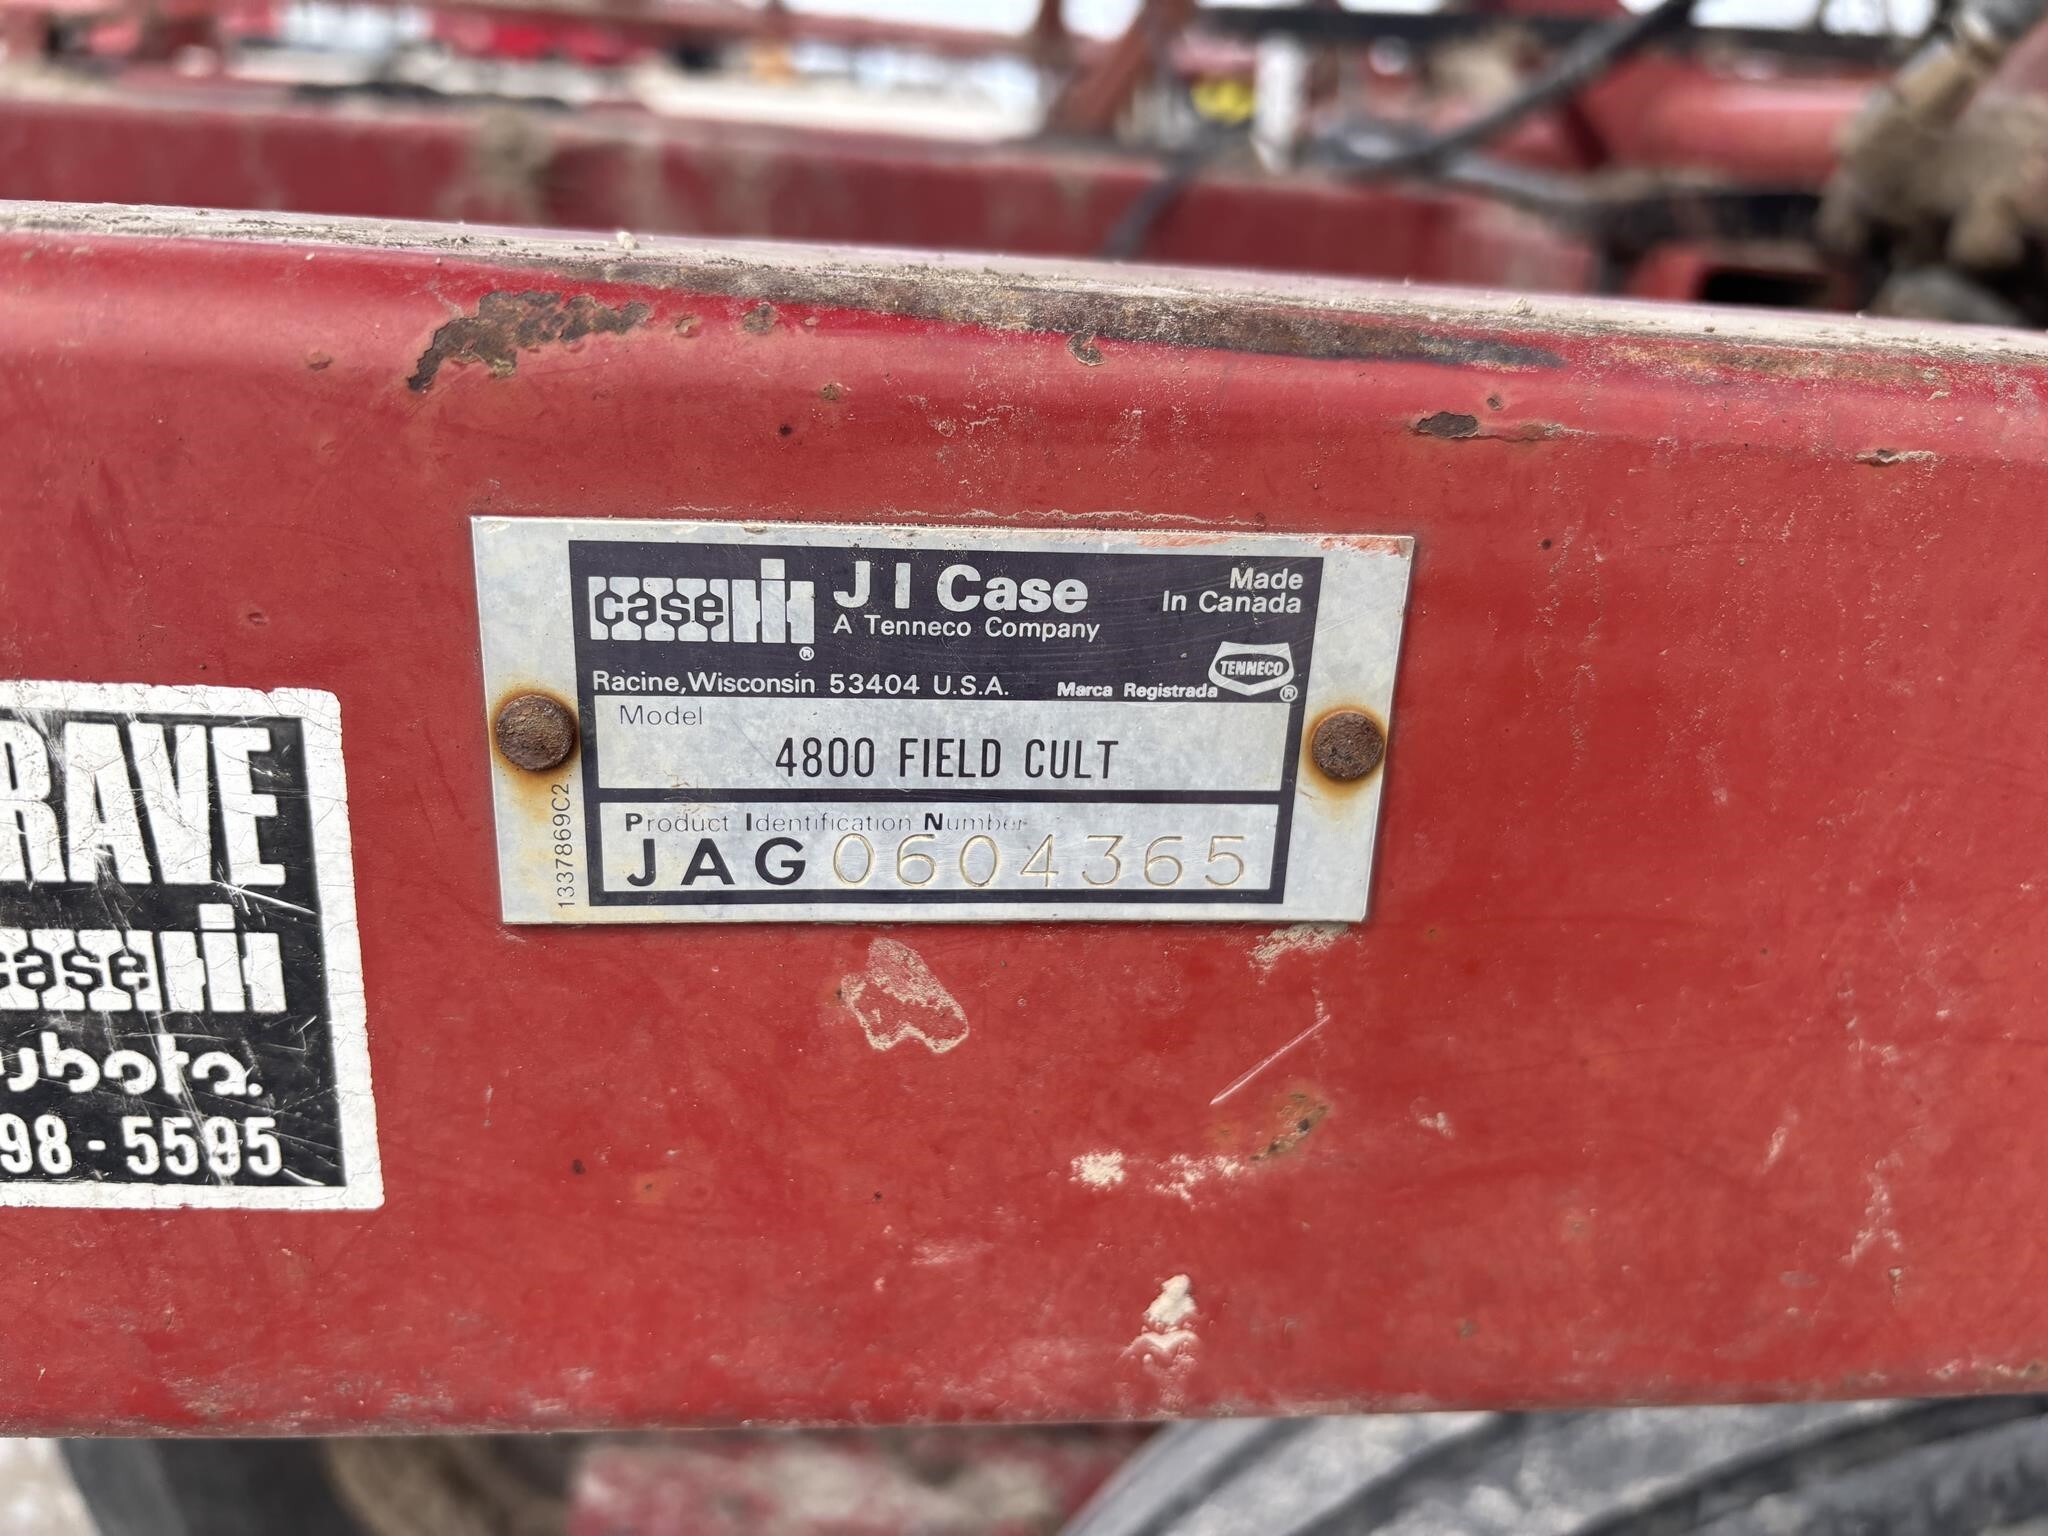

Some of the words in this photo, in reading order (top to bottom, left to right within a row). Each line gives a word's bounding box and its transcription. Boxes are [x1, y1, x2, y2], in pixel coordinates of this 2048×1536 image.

[936, 564, 1089, 613] Case
[1230, 567, 1304, 590] Made
[1162, 590, 1187, 612] In
[1199, 591, 1302, 614] Canada
[833, 614, 852, 634] A
[864, 614, 972, 637] Tenneco
[985, 616, 1100, 642] Company
[1220, 660, 1284, 677] TENNECO
[829, 673, 921, 695] 53404
[933, 674, 1010, 696] U.S.A.
[1057, 682, 1113, 697] Marca
[1124, 682, 1219, 699] Registrada
[619, 704, 703, 726] Model
[775, 737, 875, 778] 4800
[899, 738, 1001, 778] FIELD
[1023, 739, 1119, 780] CULT
[625, 812, 729, 832] Product
[745, 812, 911, 832] Identification
[924, 813, 1027, 831] Number
[551, 783, 576, 908] 1337869C2
